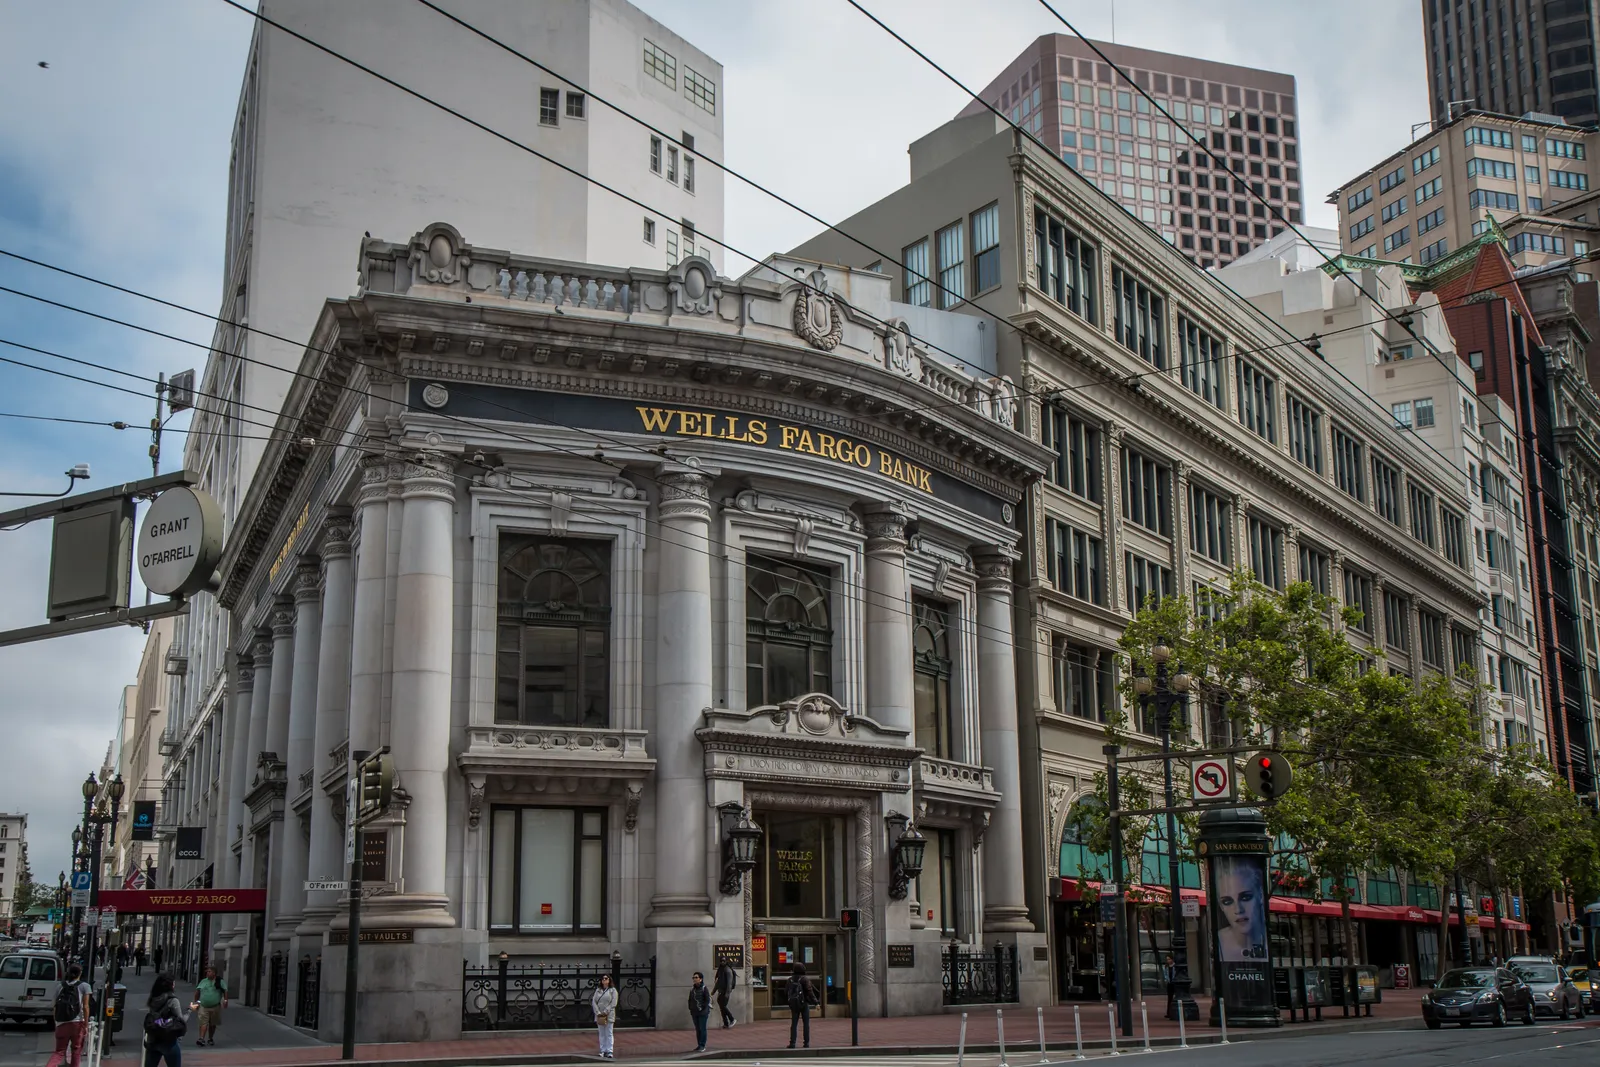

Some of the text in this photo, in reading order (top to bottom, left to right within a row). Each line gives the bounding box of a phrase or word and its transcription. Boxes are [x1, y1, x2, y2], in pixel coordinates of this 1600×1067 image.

[635, 406, 934, 494] WELLS FARGO BANK
[150, 517, 190, 538] GRANT
[142, 545, 194, 568] O'FARRELL
[1215, 843, 1264, 851] SAN FRANCISCO
[776, 850, 813, 861] WELLS
[778, 861, 813, 871] FARGO
[780, 872, 810, 882] BANK
[149, 895, 236, 905] WELLS FARGO
[374, 933, 408, 942] VAULTS
[1228, 972, 1265, 981] CHANEL
